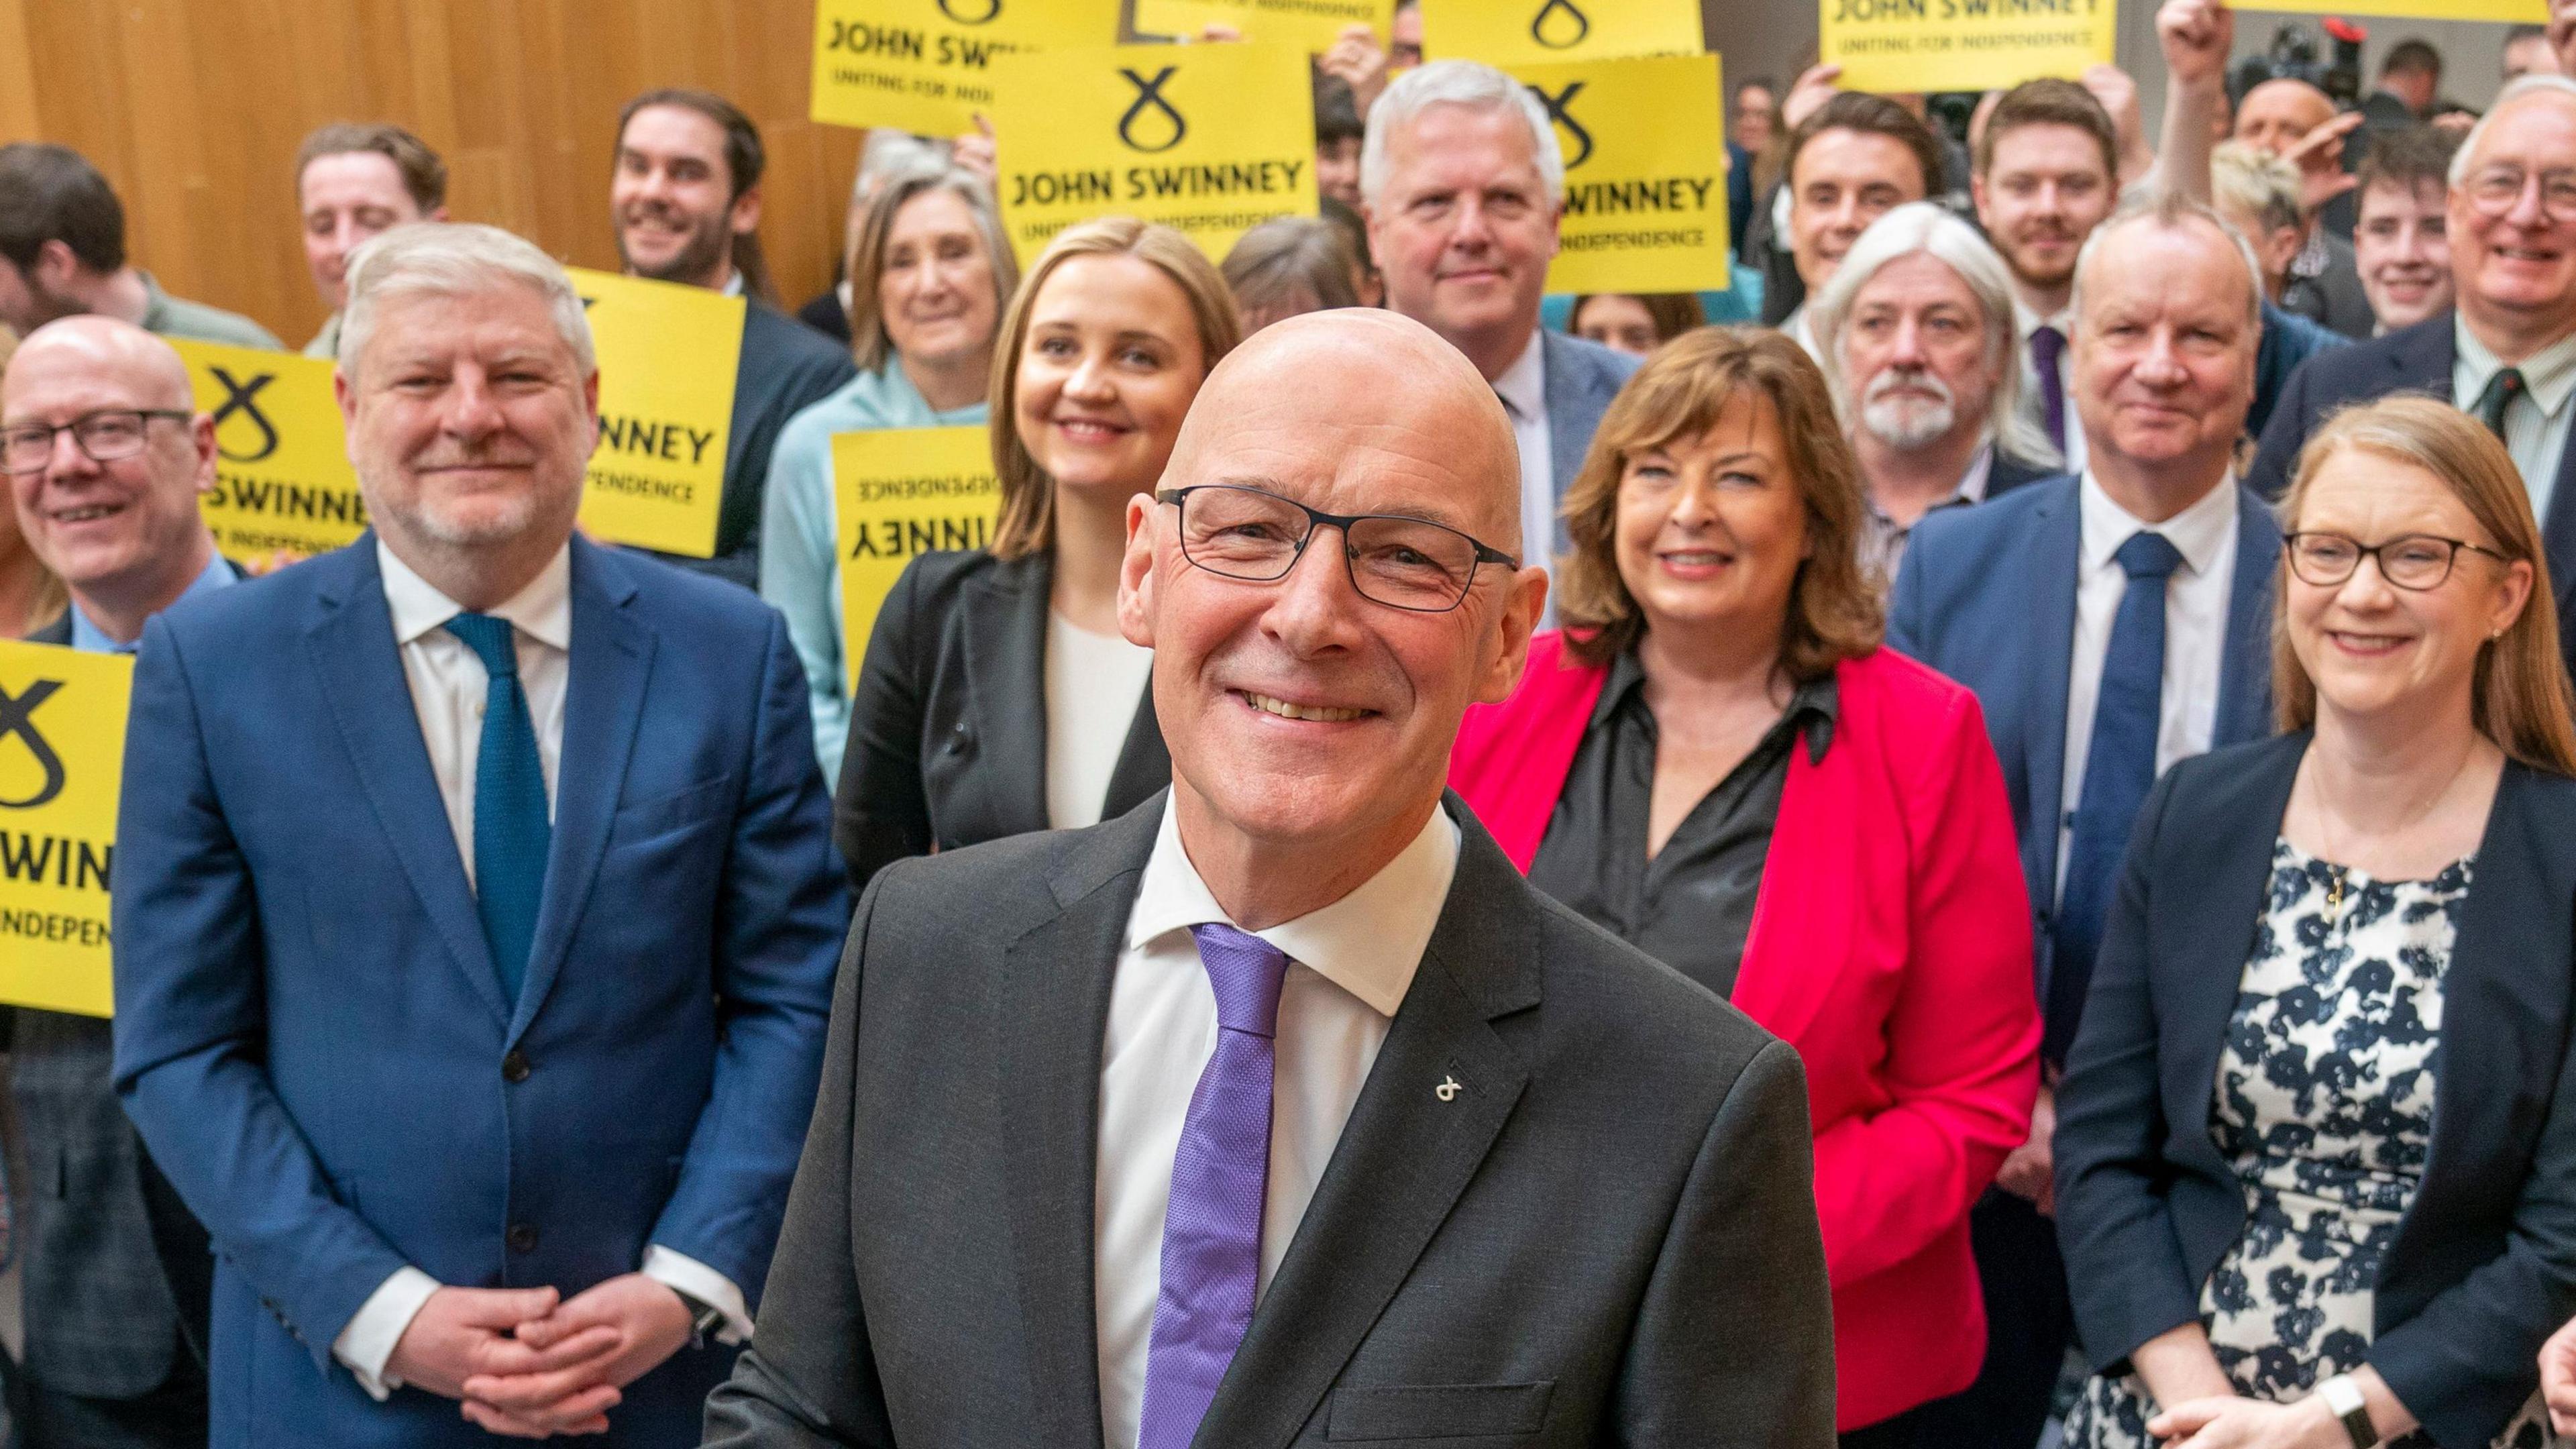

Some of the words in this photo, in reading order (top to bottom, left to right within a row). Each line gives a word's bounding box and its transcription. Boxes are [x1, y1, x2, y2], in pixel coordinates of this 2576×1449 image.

[1833, 0, 1927, 23] JOHN
[828, 17, 924, 62] JOHN
[1012, 171, 1112, 208] JOHN
[1127, 160, 1304, 200] SWINNEY
